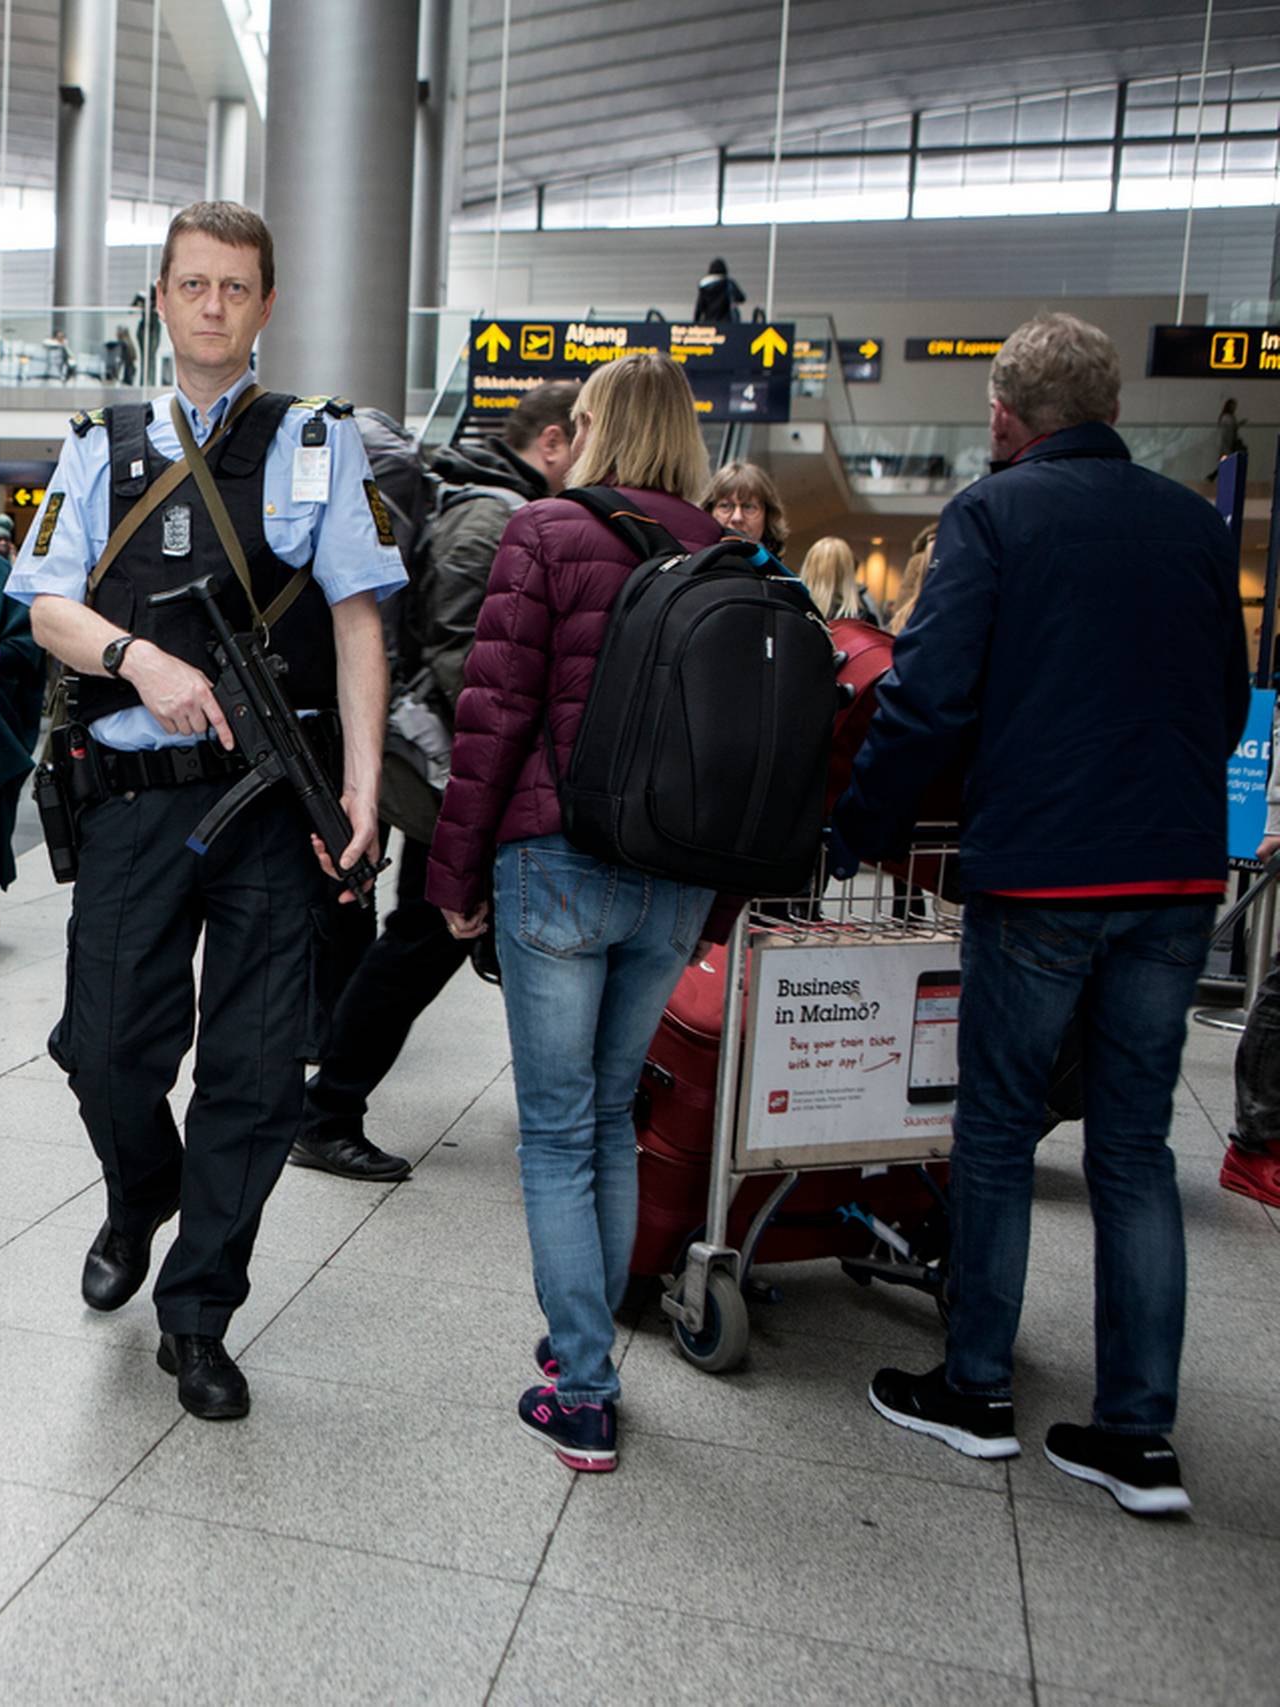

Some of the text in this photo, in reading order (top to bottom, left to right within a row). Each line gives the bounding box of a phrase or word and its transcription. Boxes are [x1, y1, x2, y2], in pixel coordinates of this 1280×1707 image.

[565, 323, 627, 346] Afgang
[743, 384, 755, 400] 4
[777, 978, 860, 997] Business
[775, 1001, 880, 1024] in Malmö?
[789, 1035, 896, 1055] Buy your train ticket
[788, 1057, 810, 1070] with
[816, 1059, 833, 1069] our
[531, 1403, 553, 1425] S
